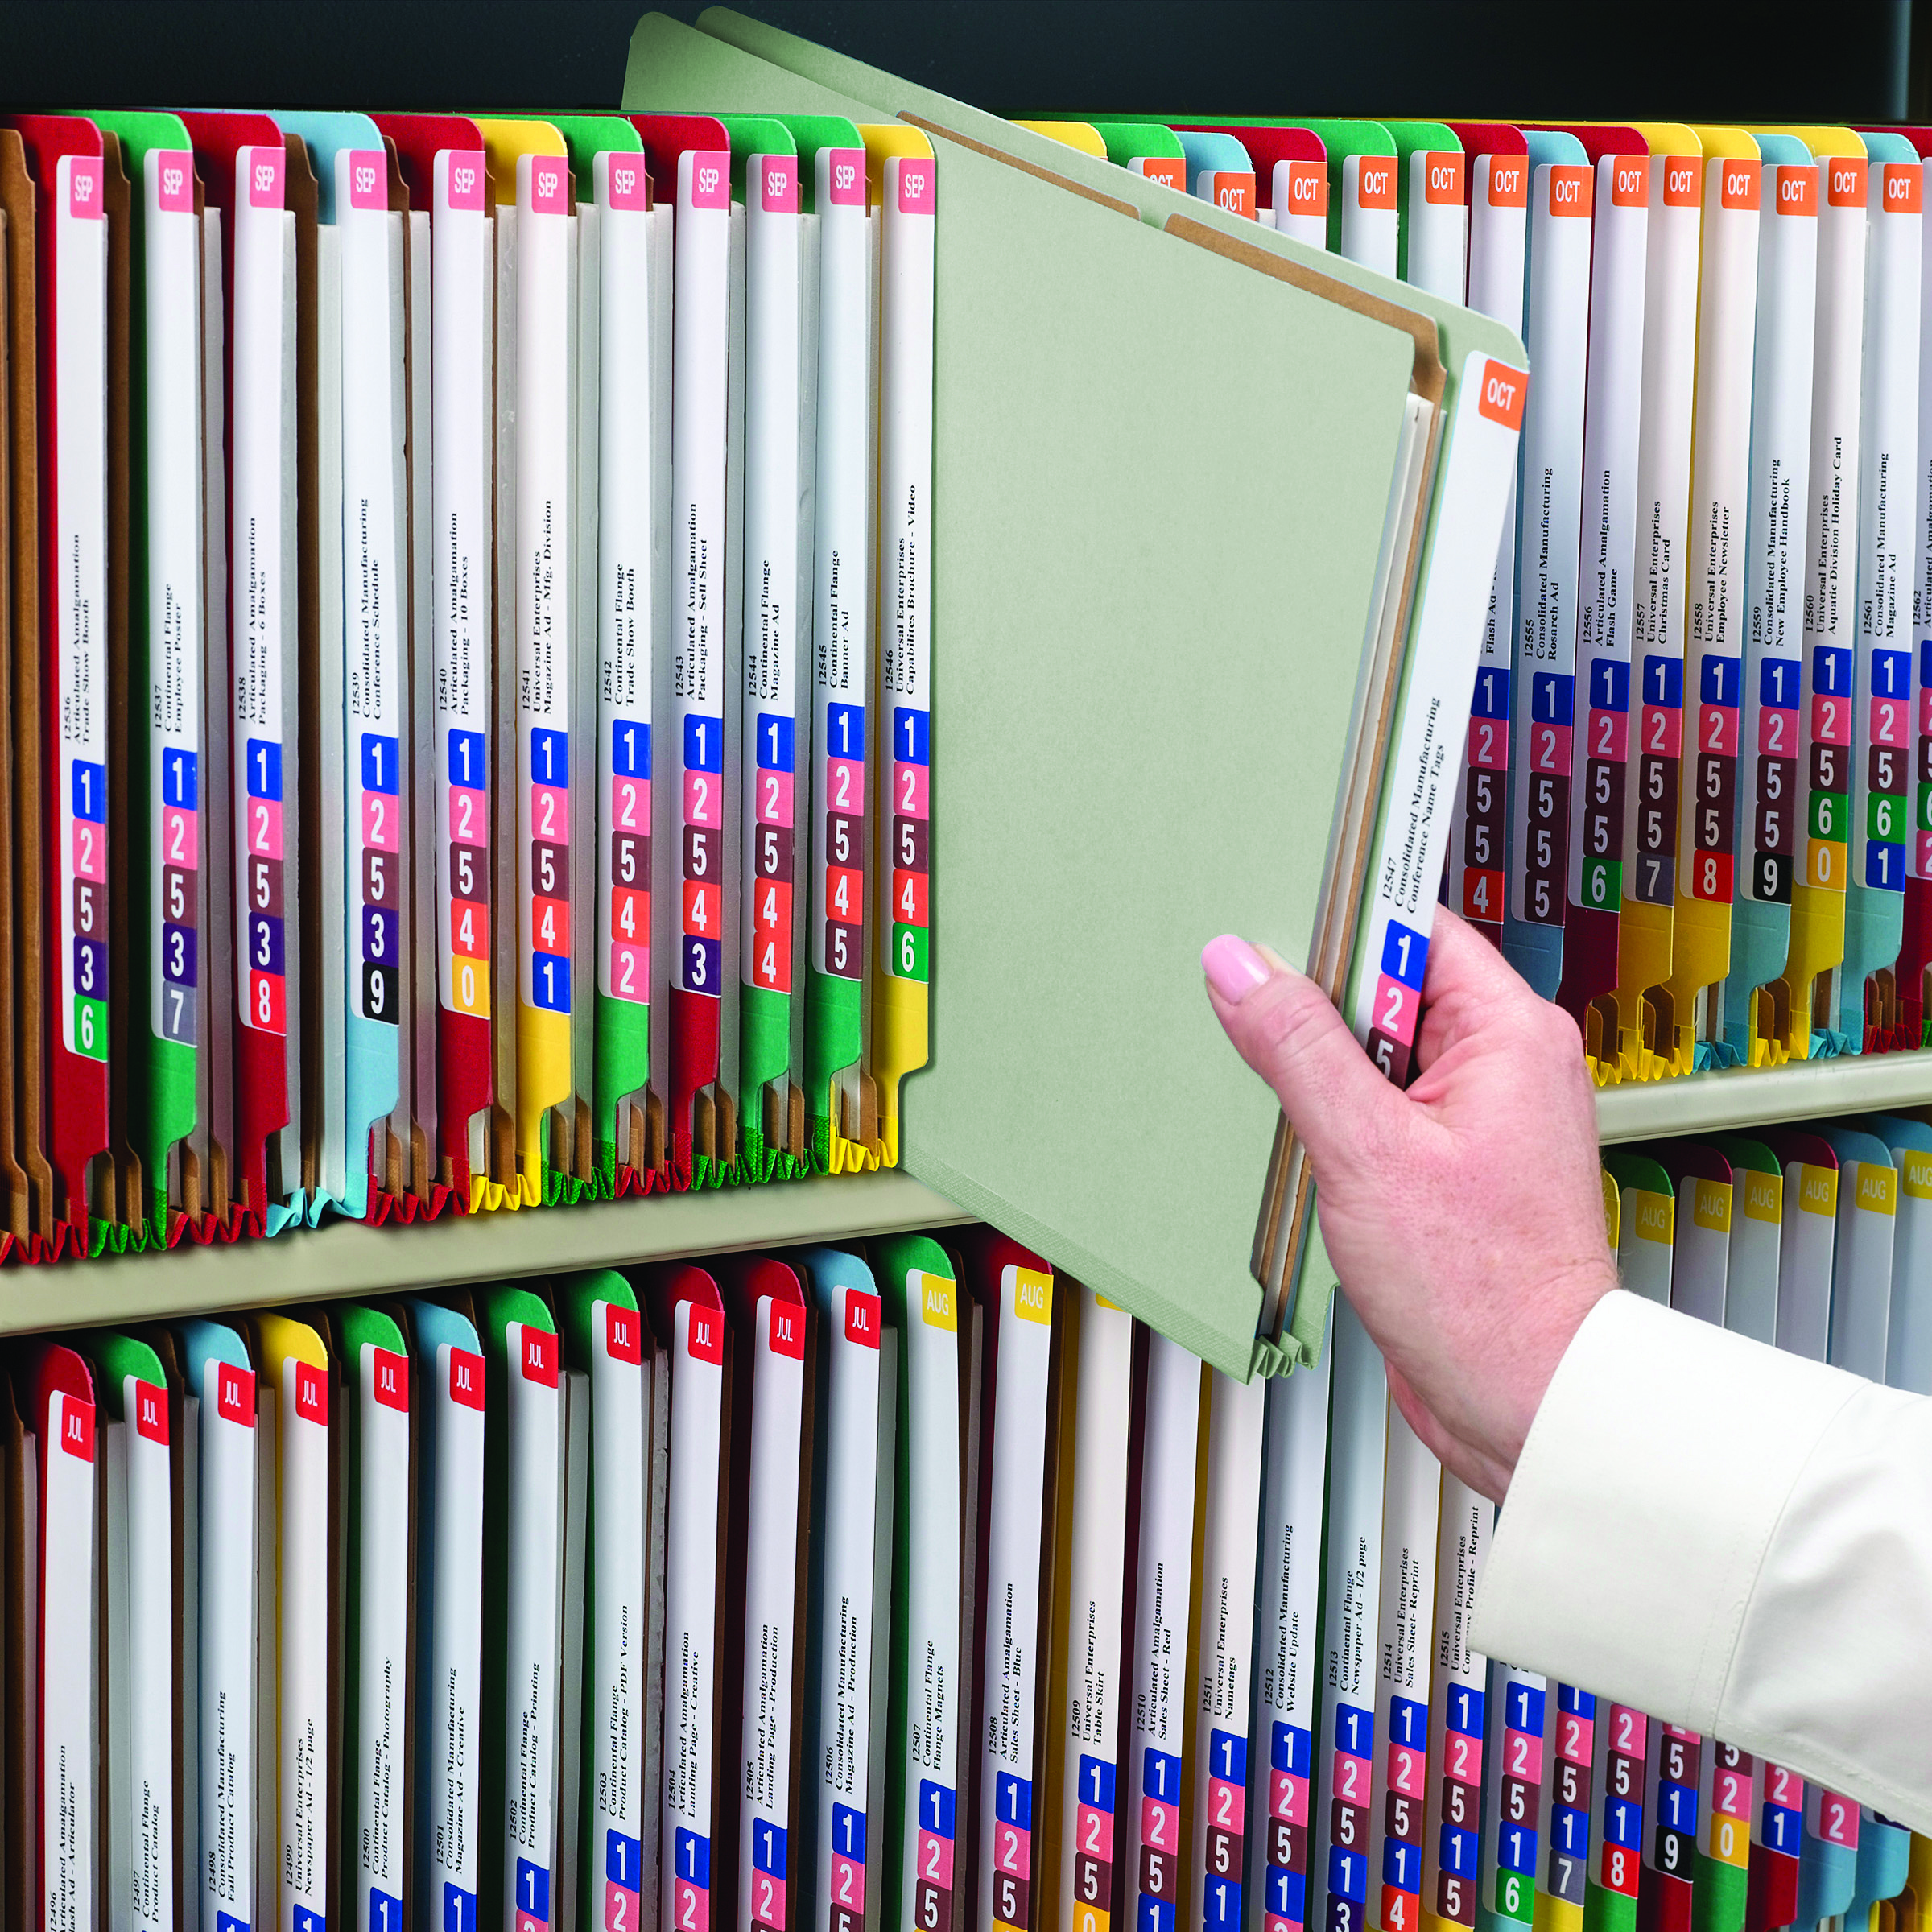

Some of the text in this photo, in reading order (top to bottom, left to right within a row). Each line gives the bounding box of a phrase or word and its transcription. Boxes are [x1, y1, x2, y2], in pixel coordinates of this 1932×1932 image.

[75, 175, 93, 201] SEP
[164, 168, 183, 195] SEP
[255, 165, 275, 191] SEP
[356, 167, 375, 192] SEP
[455, 168, 475, 193] SEP
[539, 172, 558, 197] SEP
[616, 169, 635, 194] SEP
[699, 168, 719, 192] SEP
[768, 172, 786, 196] SEP
[836, 165, 855, 189] SEP
[905, 174, 924, 198] SEP
[1432, 167, 1455, 189] OCT
[1496, 171, 1519, 192] OCT
[1556, 180, 1580, 202] OCT
[1619, 171, 1641, 192] OCT
[1670, 171, 1693, 192] OCT
[1728, 174, 1750, 196] OCT
[1782, 180, 1806, 201] OCT
[1835, 171, 1857, 193] OCT
[1889, 178, 1911, 199] OCT
[1487, 378, 1514, 408] OCT
[906, 485, 915, 526] Video
[1764, 458, 1780, 646] Consolidated Manufacturing
[1827, 436, 1842, 635] Aquatic Division Holiday Card
[1874, 452, 1889, 637] Consolidated Manufacturing
[906, 541, 915, 609] Brochure
[1536, 467, 1553, 659] Consolidated Manufacturing
[1647, 500, 1662, 642] Universal Enterprises
[1704, 501, 1719, 642] Universal Enterprises
[1716, 506, 1729, 643] Employee Newsletter
[1775, 477, 1790, 646] New Employee Handbook
[1816, 494, 1830, 633] Universal Enterprises
[358, 498, 370, 718] Consolidated Manufacturing
[1658, 539, 1670, 644] Christmas Card
[1804, 593, 1814, 631] 12560
[1885, 553, 1896, 638] Magazine Ad
[613, 563, 625, 705] Continental Flange
[758, 559, 770, 700] Continental Flange
[828, 550, 840, 688] Continental Flange
[895, 537, 906, 692] Universal Enterprises
[1548, 581, 1559, 661] Rosarch Ad
[1635, 602, 1645, 641] 12557
[1693, 602, 1703, 640] 12558
[1752, 605, 1761, 643] 12559
[1863, 599, 1872, 634] 12561
[163, 583, 173, 732] Continental Flange
[370, 559, 381, 720] Conference Schedule
[625, 568, 634, 707] Trade Show Booth
[770, 604, 780, 700] Magazine Ad
[840, 610, 848, 689] Banner Ad
[906, 614, 916, 695] Capabilites
[1524, 618, 1534, 657] 12555
[173, 602, 184, 733] Employee Poster
[603, 660, 612, 702] 12542
[748, 654, 757, 696] 12544
[817, 643, 827, 685] 12545
[884, 648, 894, 693] 12546
[153, 683, 162, 729] 12537
[351, 671, 360, 714] 12539
[1394, 696, 1440, 907] Consolidated Manufacturing
[1406, 744, 1444, 914] Conference Name Tags
[1381, 856, 1396, 899] 12547
[1700, 1196, 1724, 1217] AUG
[1862, 1179, 1885, 1199] AUG
[927, 1290, 948, 1315] AUG
[1020, 1284, 1043, 1308] AUG
[696, 1322, 712, 1347] JUL
[777, 1317, 793, 1341] JUL
[852, 1307, 869, 1331] JUL
[529, 1343, 543, 1368] JUL
[225, 1381, 240, 1407] JUL
[381, 1367, 396, 1393] JUL
[68, 1415, 83, 1442] JUL
[1276, 1524, 1293, 1709] Consolidated Manufacturing
[1394, 1547, 1409, 1683] Universal Enterprises
[1406, 1559, 1420, 1688] Sales Sheet- Reprint
[1214, 1576, 1228, 1716] Universal Enterprises
[1287, 1611, 1299, 1711] Website Update
[1383, 1642, 1393, 1680] 12514
[1083, 1600, 1096, 1741] Universal Enterprises
[1224, 1657, 1236, 1720] Nametags
[1265, 1667, 1274, 1706] 12512
[923, 1639, 935, 1767] Continental Flange
[1093, 1670, 1104, 1745] Table Skirt
[1203, 1675, 1212, 1713] 12511
[934, 1665, 944, 1771] Flange Magnets
[1071, 1699, 1080, 1738] 12509
[911, 1722, 921, 1762] 12507
[217, 1690, 226, 1897] Consolidated Manufacturing
[226, 1752, 235, 1808] Catalog
[141, 1780, 150, 1828] Flange
[151, 1804, 159, 1860] Catalog
[132, 1869, 140, 1912] 12497
[208, 1850, 216, 1893] 12498
